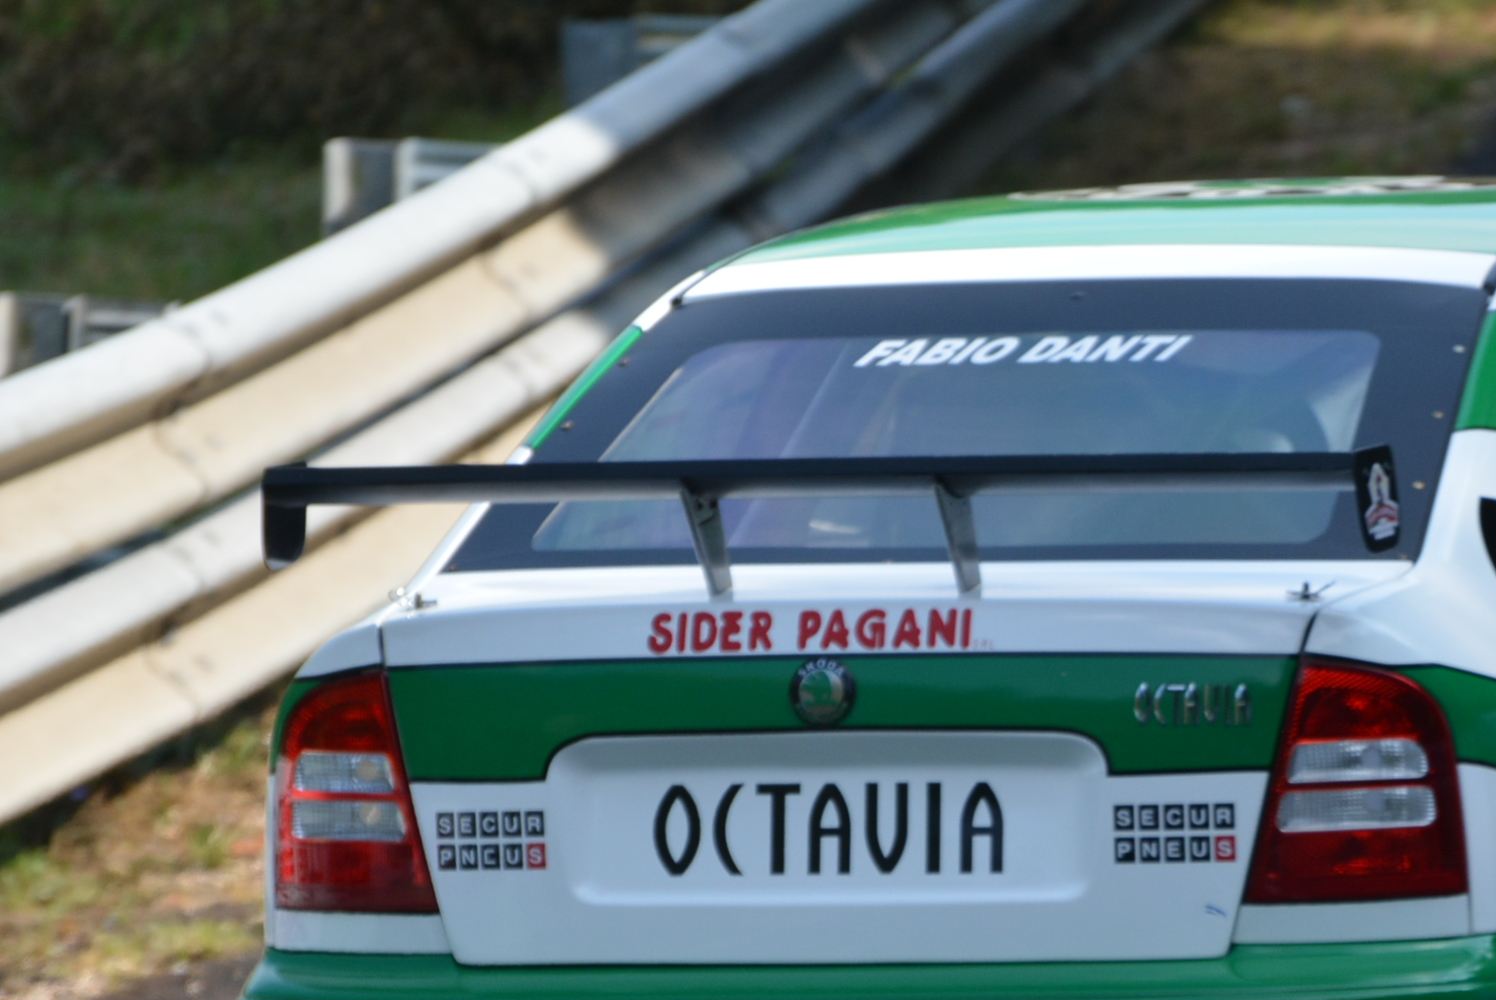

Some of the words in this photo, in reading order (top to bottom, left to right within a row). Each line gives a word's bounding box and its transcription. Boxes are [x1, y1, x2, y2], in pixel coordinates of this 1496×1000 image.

[854, 336, 1017, 367] FABIO
[1017, 334, 1193, 364] DANTI
[647, 611, 773, 654] SIDER
[797, 608, 972, 651] PAGANI
[1133, 682, 1252, 726] OCTAVIA
[437, 811, 545, 837] SECUR
[653, 782, 1003, 876] OCTAVIA
[1114, 803, 1235, 830] SECUR
[1115, 836, 1236, 863] PNEUS
